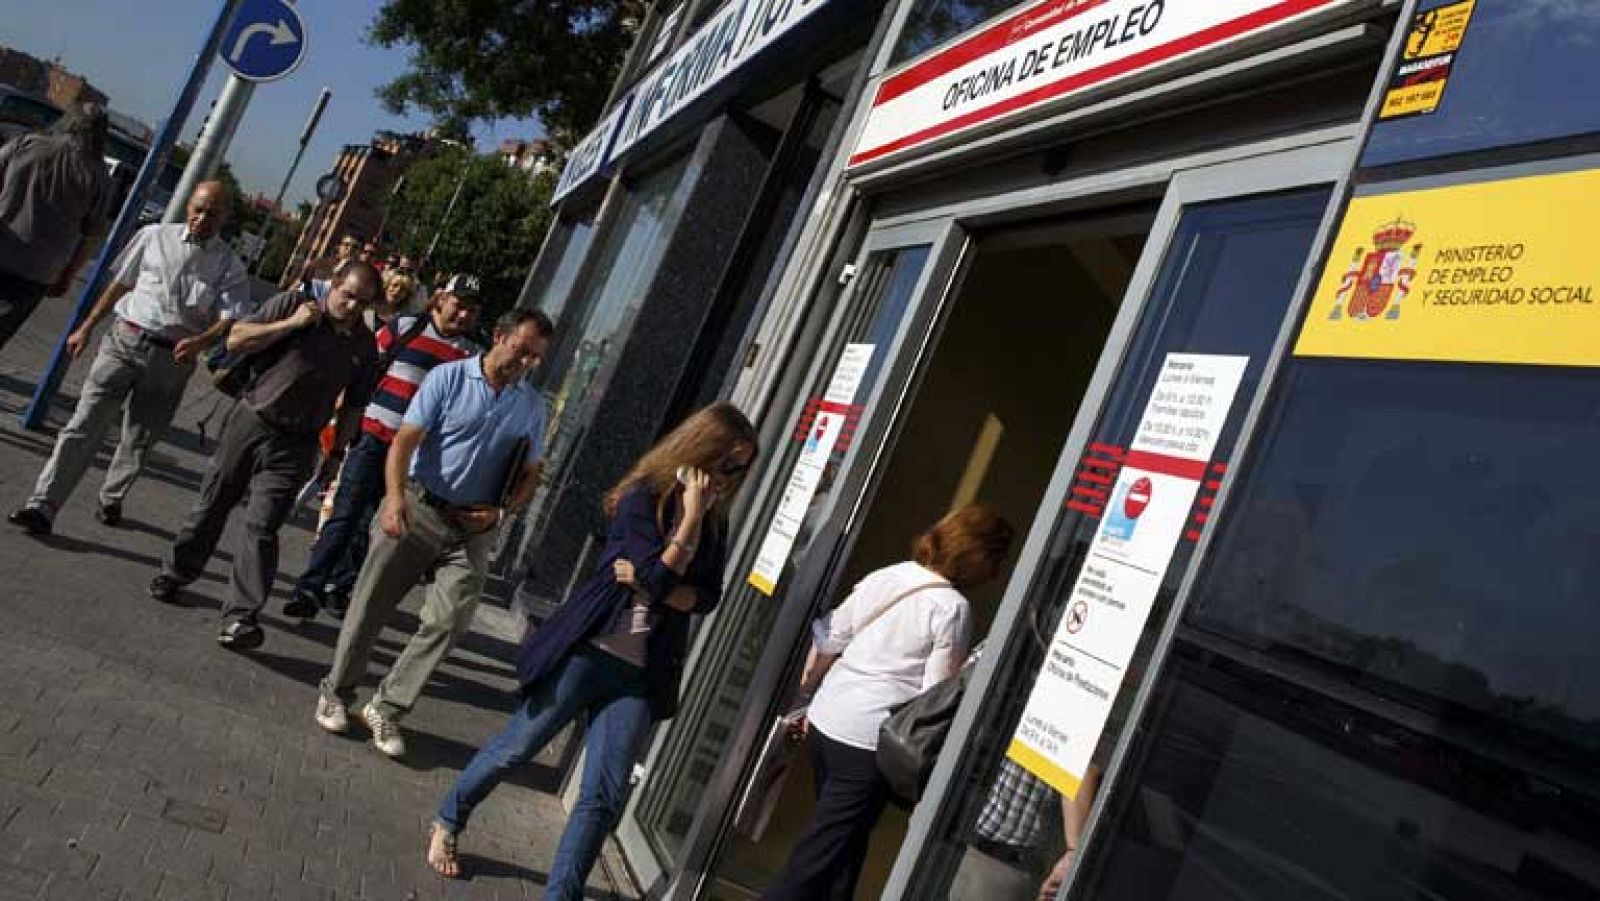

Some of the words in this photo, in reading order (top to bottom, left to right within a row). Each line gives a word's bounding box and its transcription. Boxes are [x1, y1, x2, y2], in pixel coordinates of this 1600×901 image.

[942, 58, 1017, 110] OFICINA
[1017, 42, 1053, 82] DE
[1052, 0, 1165, 69] EMPLEO
[1435, 244, 1525, 264] MINISTERIO
[1427, 268, 1451, 285] DE
[1451, 267, 1514, 284] EMPLEO
[1422, 289, 1433, 305] Y
[1433, 287, 1526, 305] SEGURIDAD
[1528, 285, 1594, 304] SOCIAL
